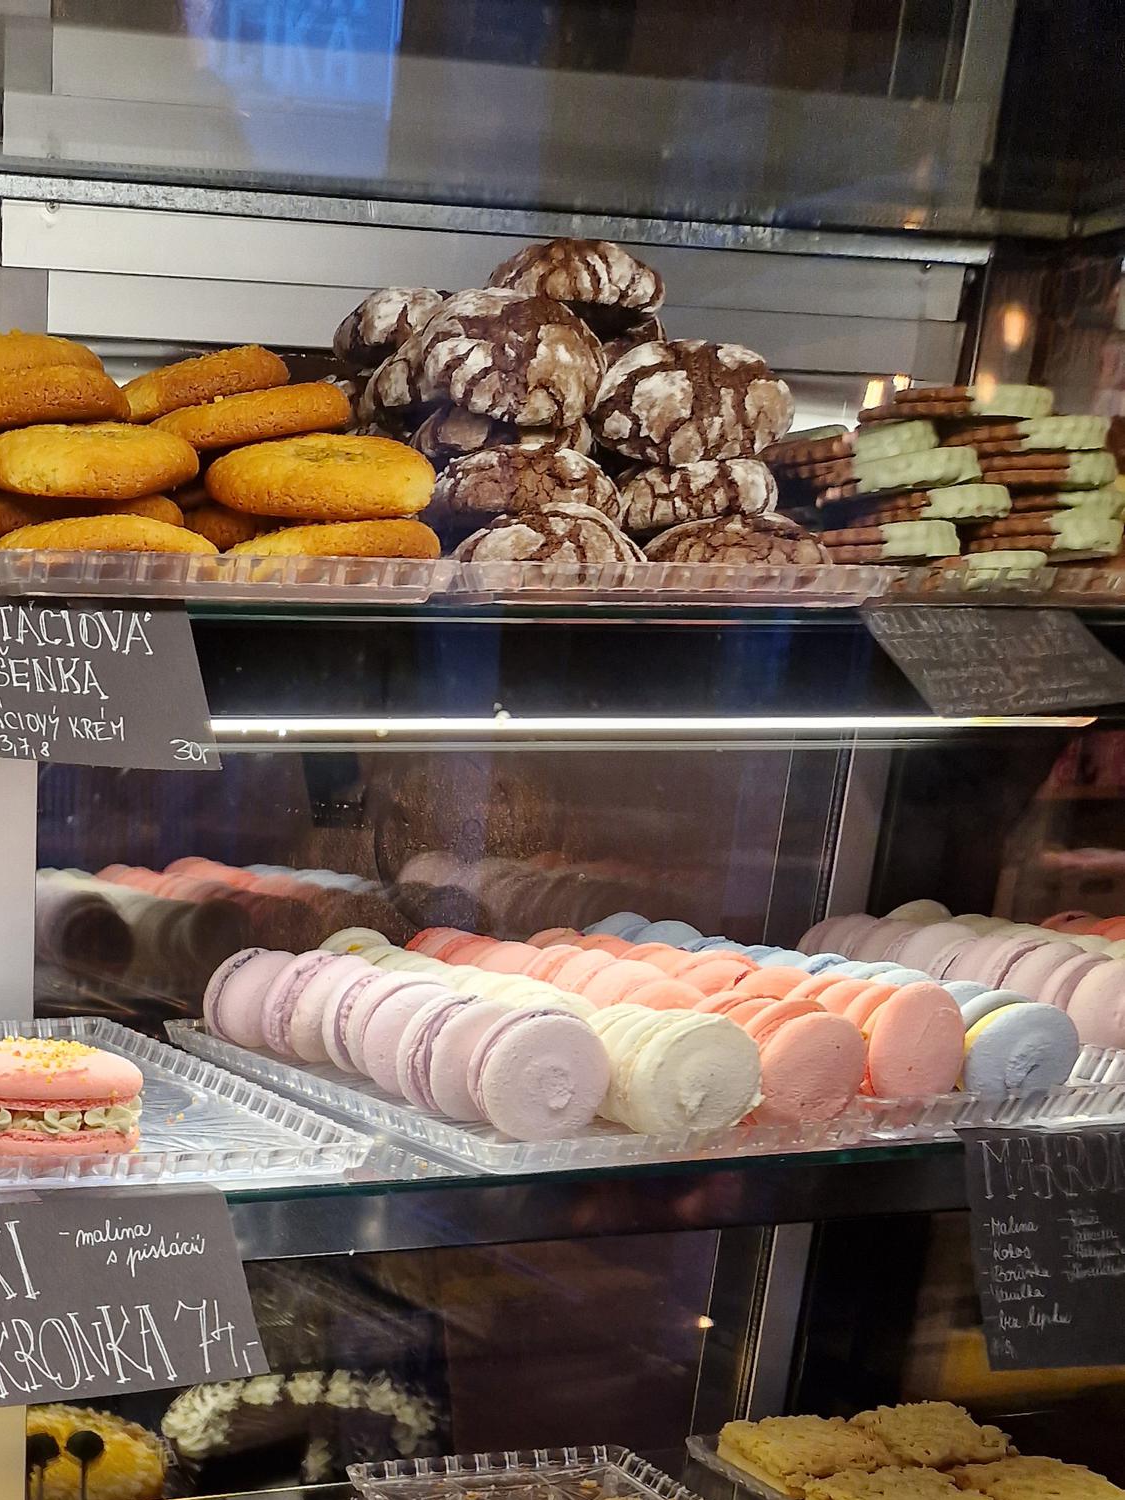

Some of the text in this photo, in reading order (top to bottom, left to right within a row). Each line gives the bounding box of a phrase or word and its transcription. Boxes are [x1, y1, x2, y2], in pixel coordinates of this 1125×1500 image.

[69, 707, 126, 741] KRÉM
[106, 1249, 118, 1266] s
[174, 1299, 259, 1375] 74,-
